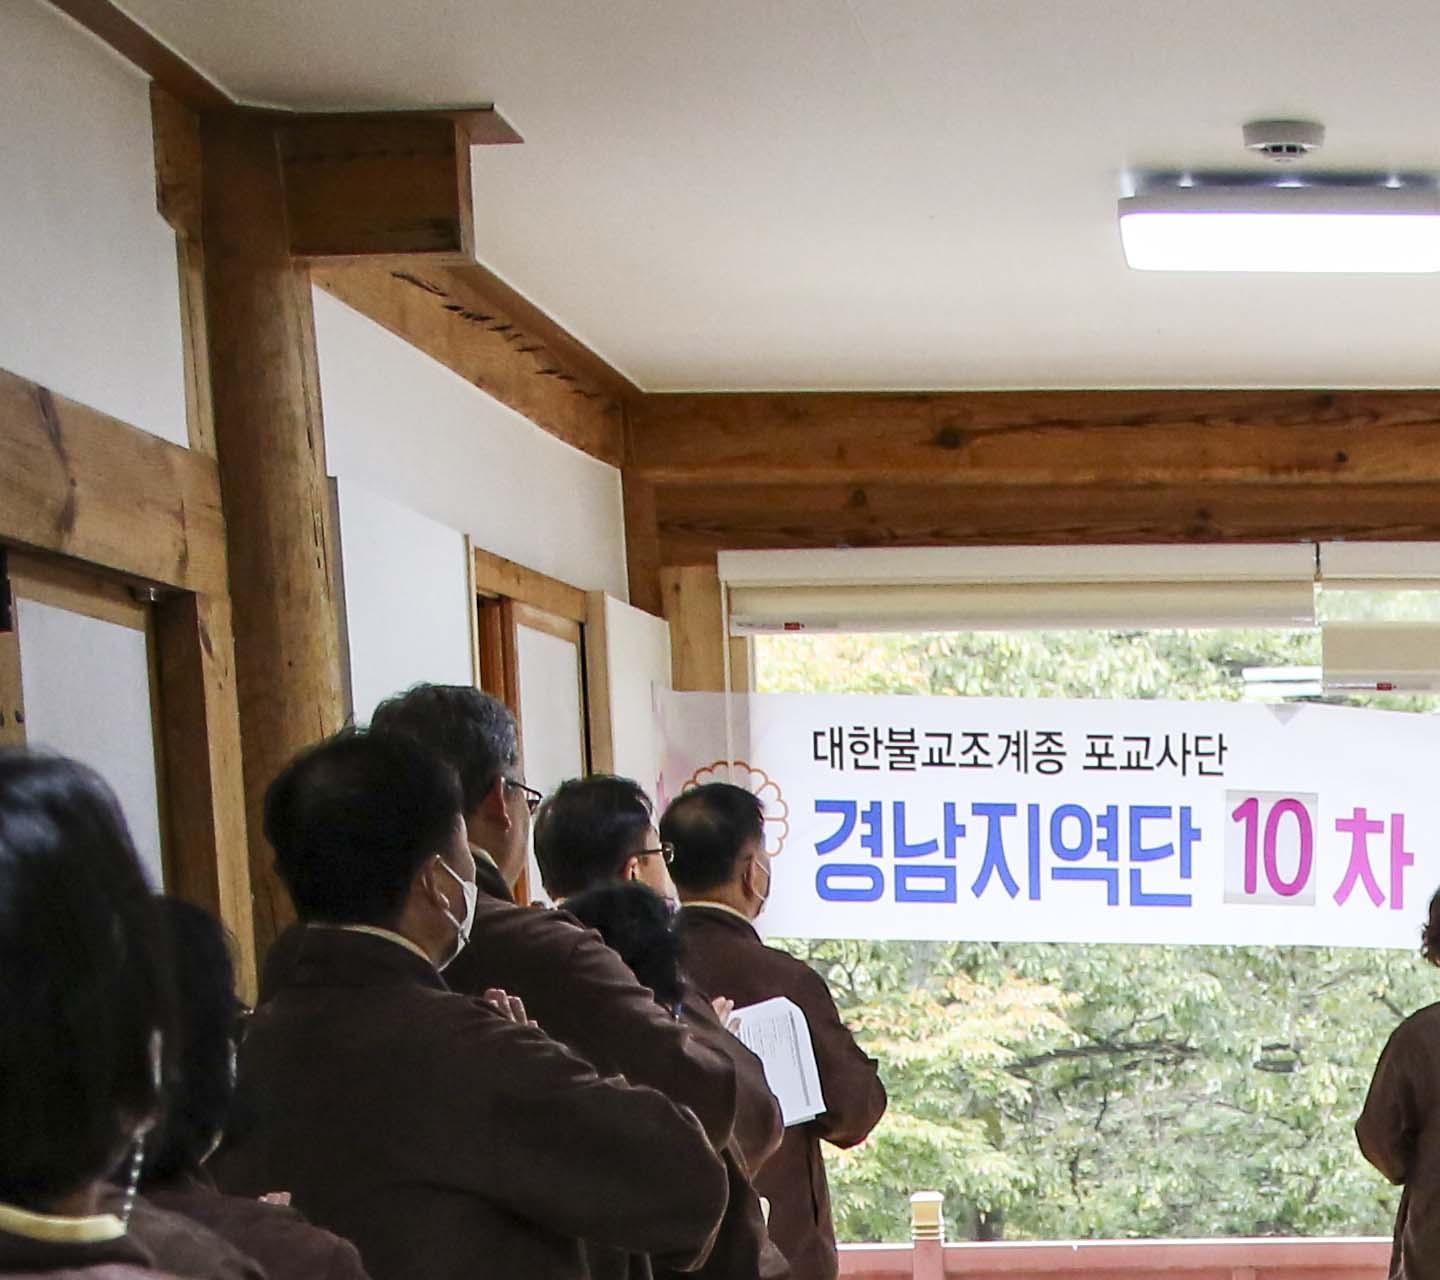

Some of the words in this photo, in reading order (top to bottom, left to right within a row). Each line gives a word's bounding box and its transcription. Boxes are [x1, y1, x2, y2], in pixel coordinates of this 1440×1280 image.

[812, 725, 1068, 776] 대한불교조계종
[1081, 730, 1229, 777] 포교사단
[813, 799, 1202, 907] 경남지역단
